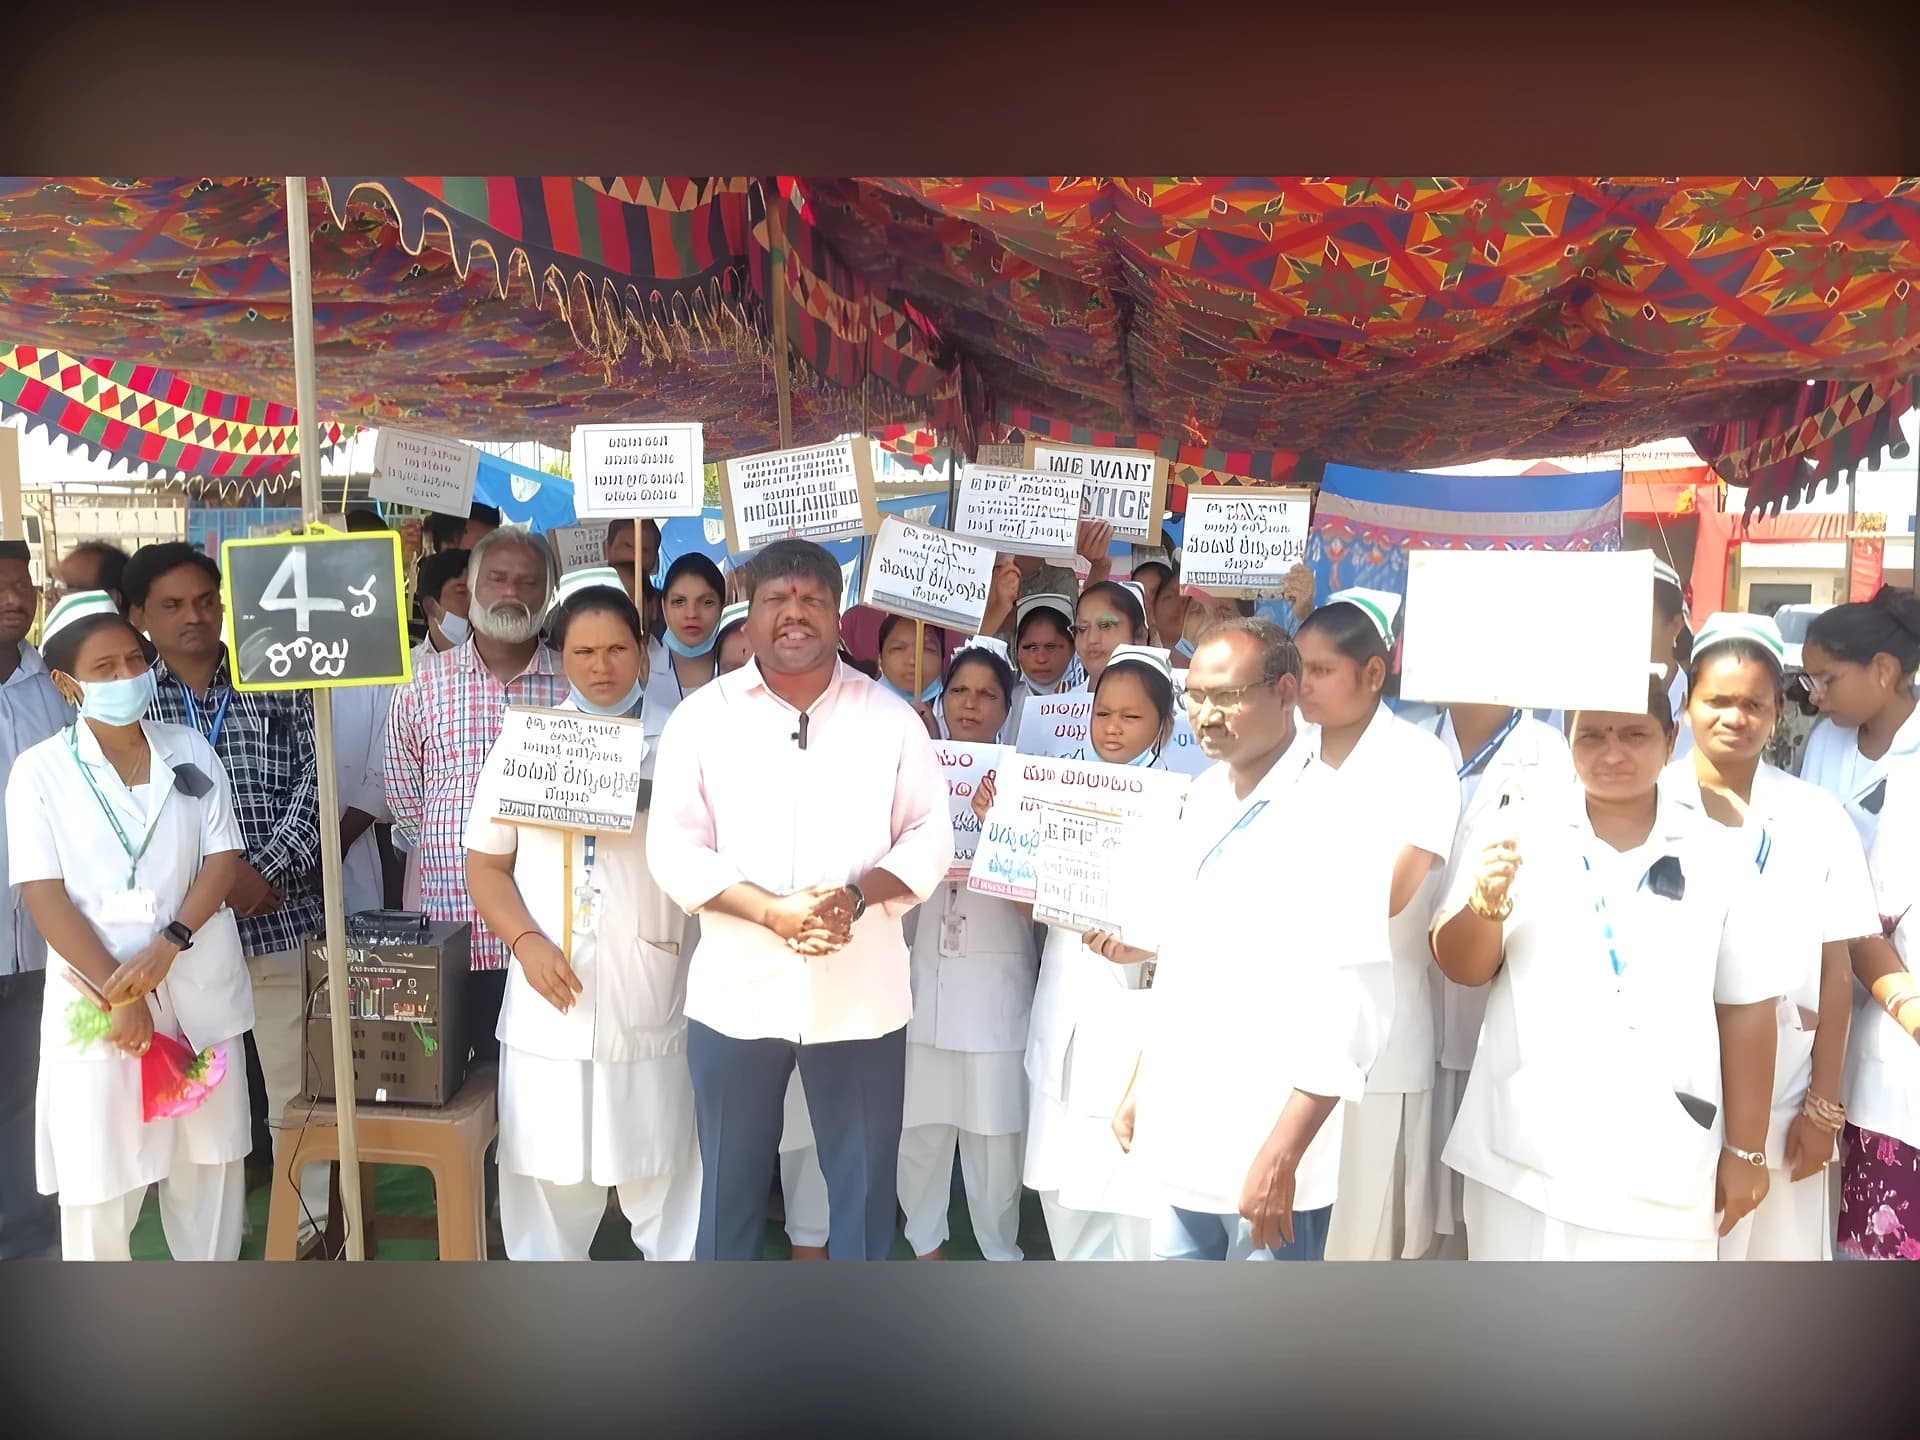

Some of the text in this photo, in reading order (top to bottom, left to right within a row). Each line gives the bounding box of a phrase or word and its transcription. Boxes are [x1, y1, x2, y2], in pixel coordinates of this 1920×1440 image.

[1090, 458, 1151, 482] WANT
[1080, 483, 1151, 521] STICE
[265, 636, 348, 677] రోజు
